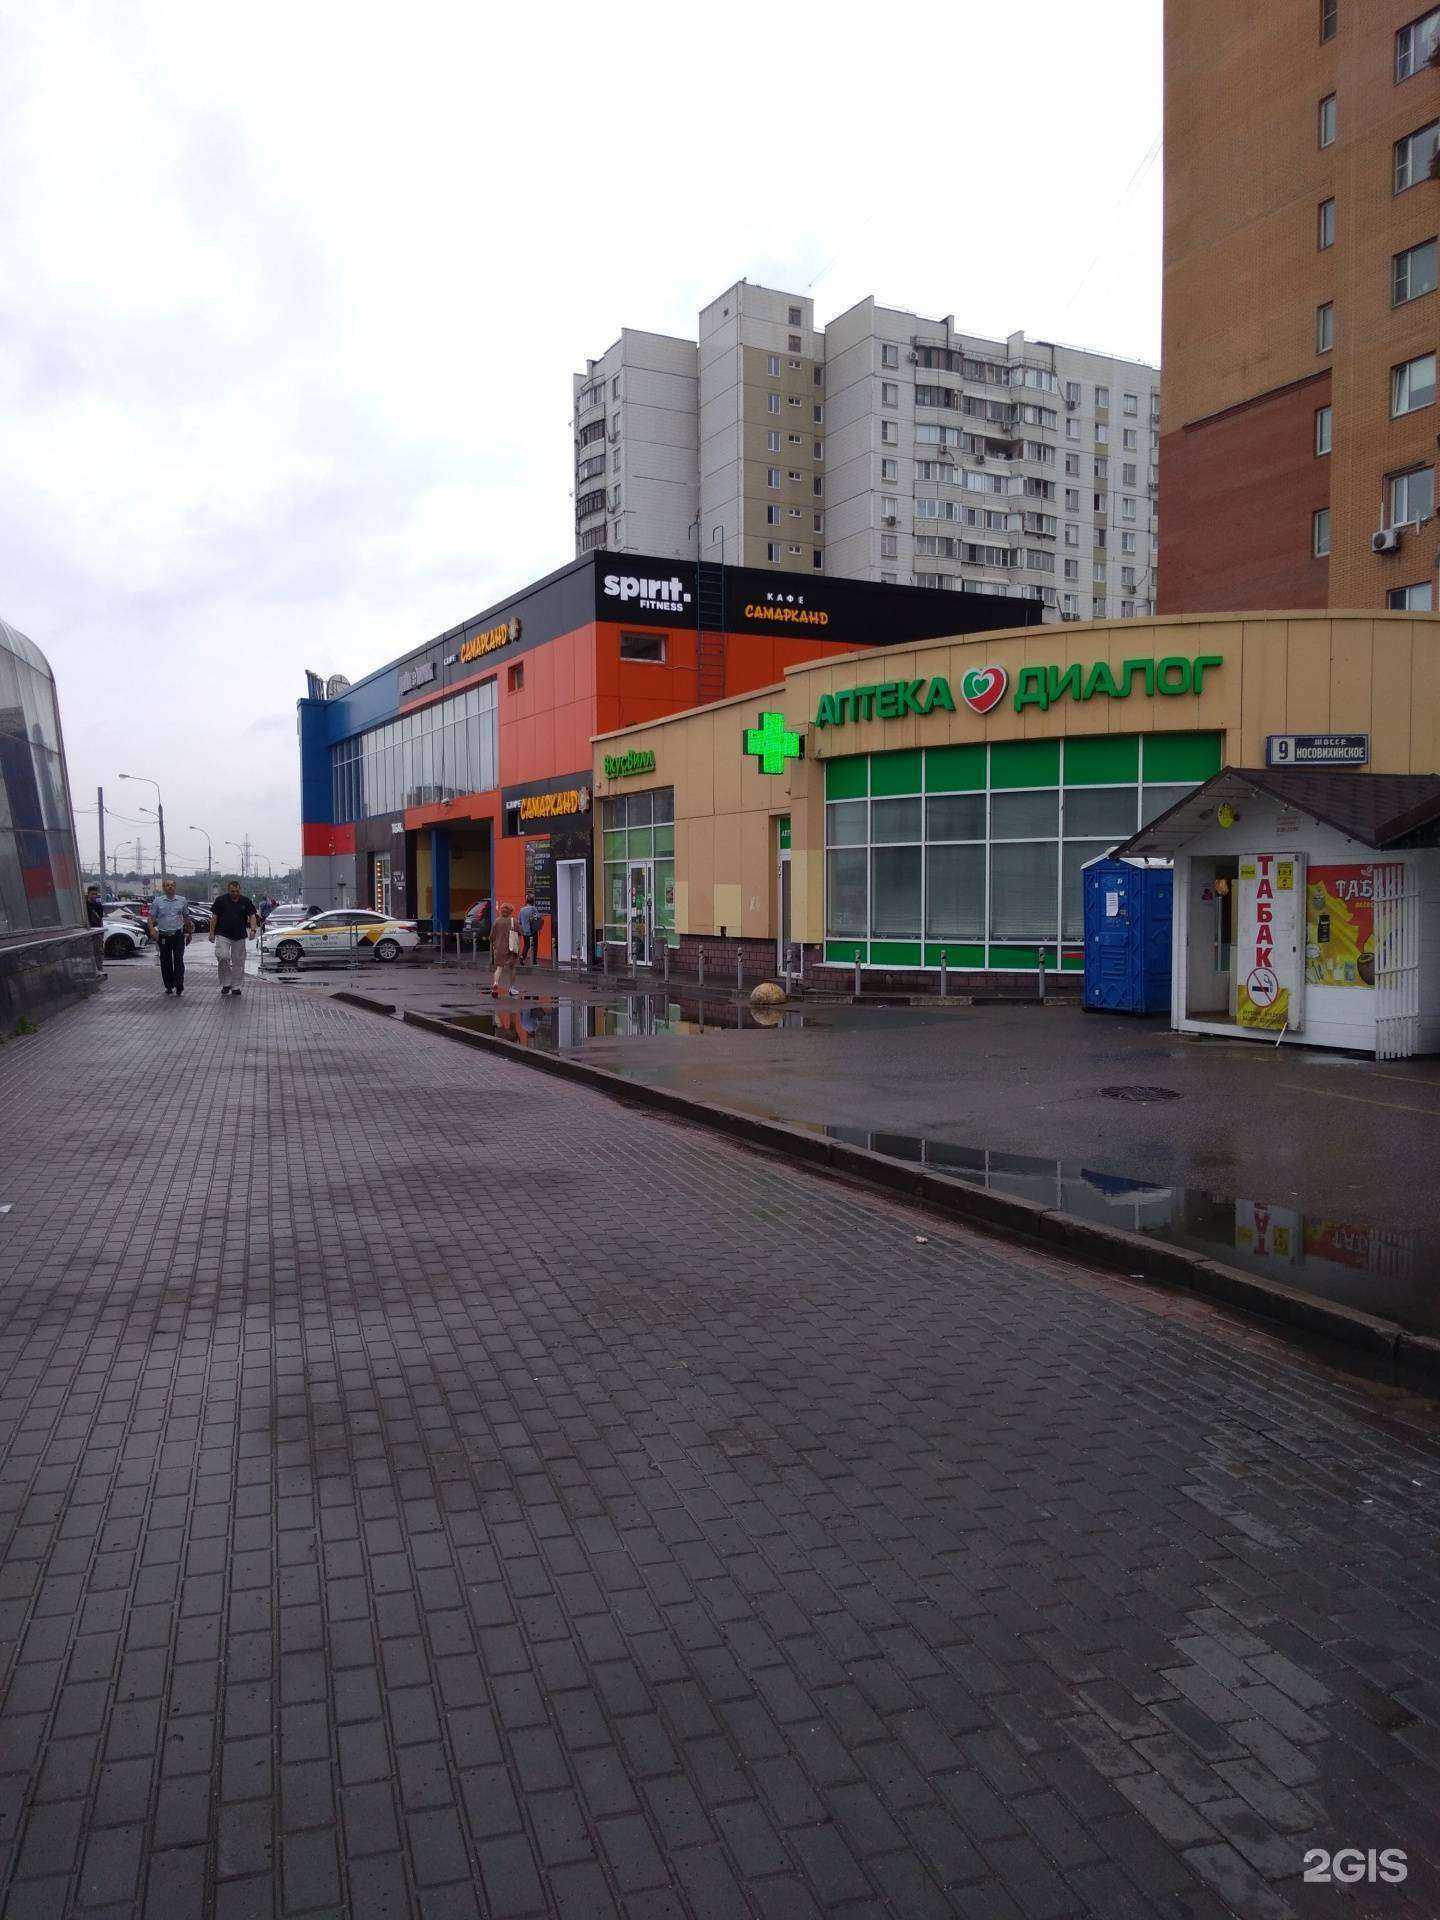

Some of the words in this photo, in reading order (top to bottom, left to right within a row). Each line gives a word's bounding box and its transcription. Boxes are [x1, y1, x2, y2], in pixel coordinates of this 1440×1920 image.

[640, 600, 683, 612] FITNESS
[766, 592, 804, 604] КАФЕ
[744, 604, 828, 625] САМАРКАНД
[460, 623, 509, 664] САМАРКАНД
[814, 677, 956, 729] АПТЕКА
[1014, 655, 1223, 713] ДИАЛОГ
[1278, 740, 1288, 760] 9
[1296, 747, 1364, 759] НОСОВИХИНСКОЕ
[520, 789, 580, 820] САМАРКАНД
[1256, 855, 1274, 968] ТАБАК
